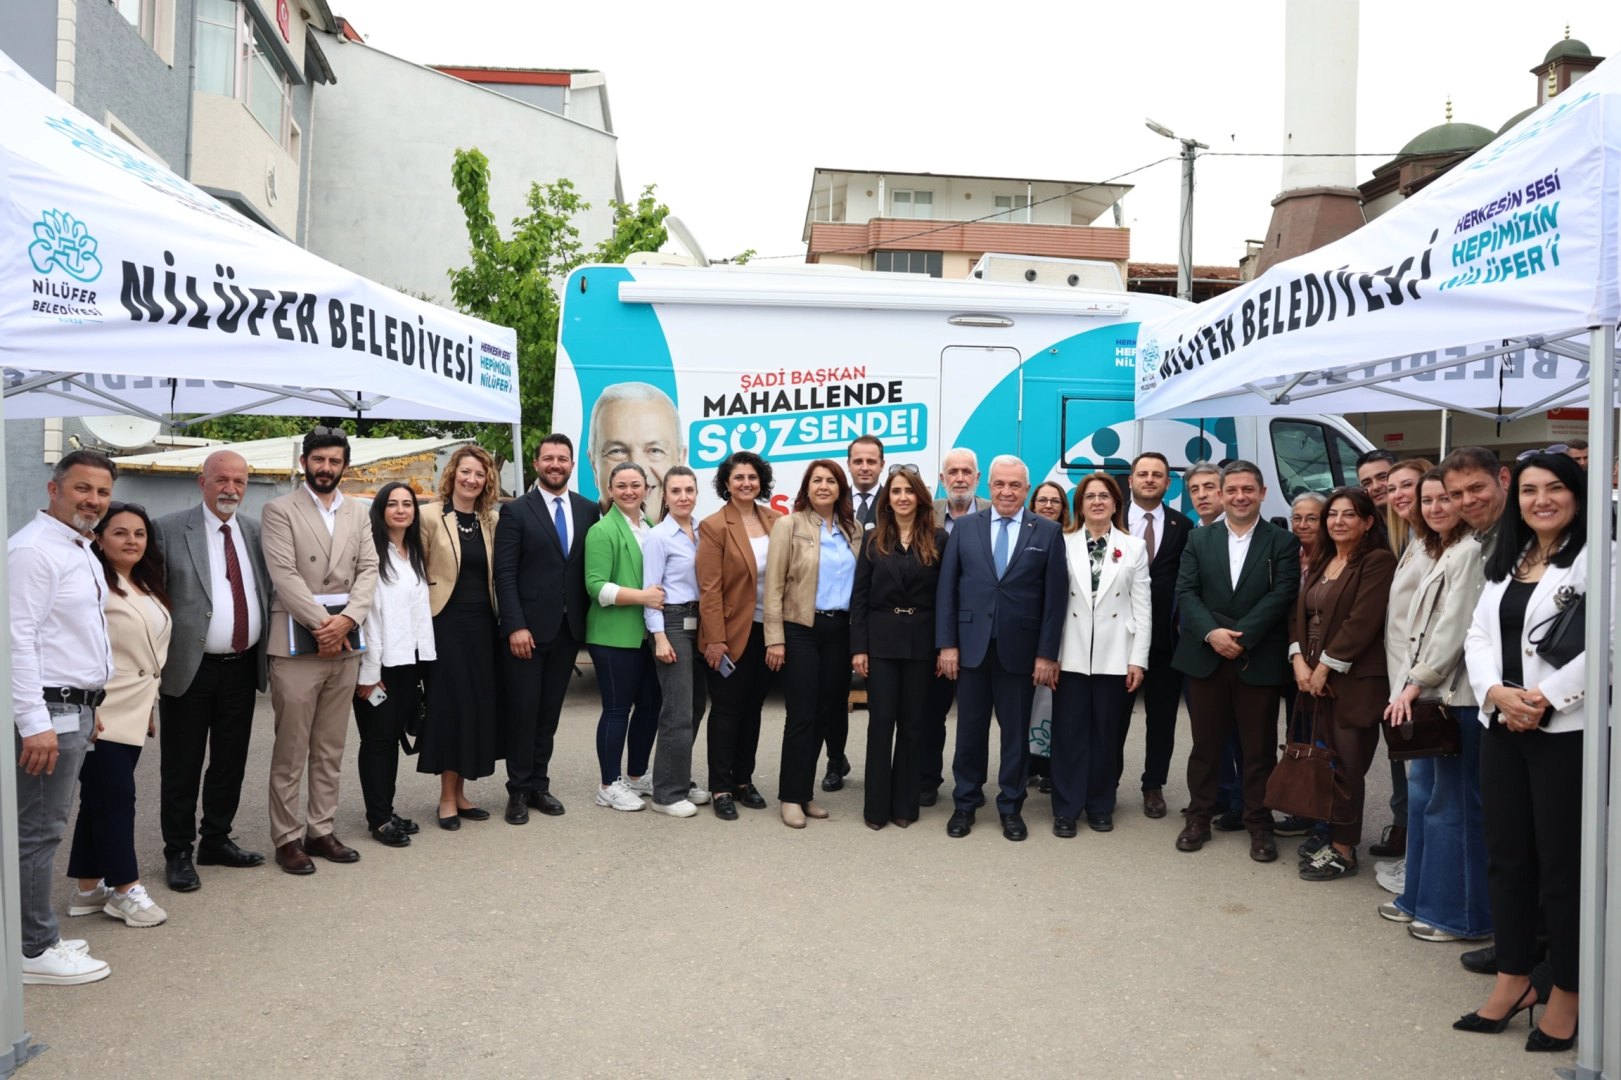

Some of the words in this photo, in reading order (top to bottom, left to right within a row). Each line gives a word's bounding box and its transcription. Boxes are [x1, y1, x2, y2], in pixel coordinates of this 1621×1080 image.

[1454, 190, 1523, 235] HERKESİN
[1525, 168, 1561, 205] SESİ
[1452, 200, 1560, 268] HEPİMİZİN
[32, 278, 97, 305] NİLÜFER
[32, 300, 103, 317] BELEDİYESİ
[121, 250, 319, 345] NİLÜFER
[328, 298, 473, 385] BELEDİYESİ
[741, 367, 786, 393] ŞADİ
[791, 365, 866, 388] BAŞKAN
[703, 380, 903, 418] MAHALLENDE
